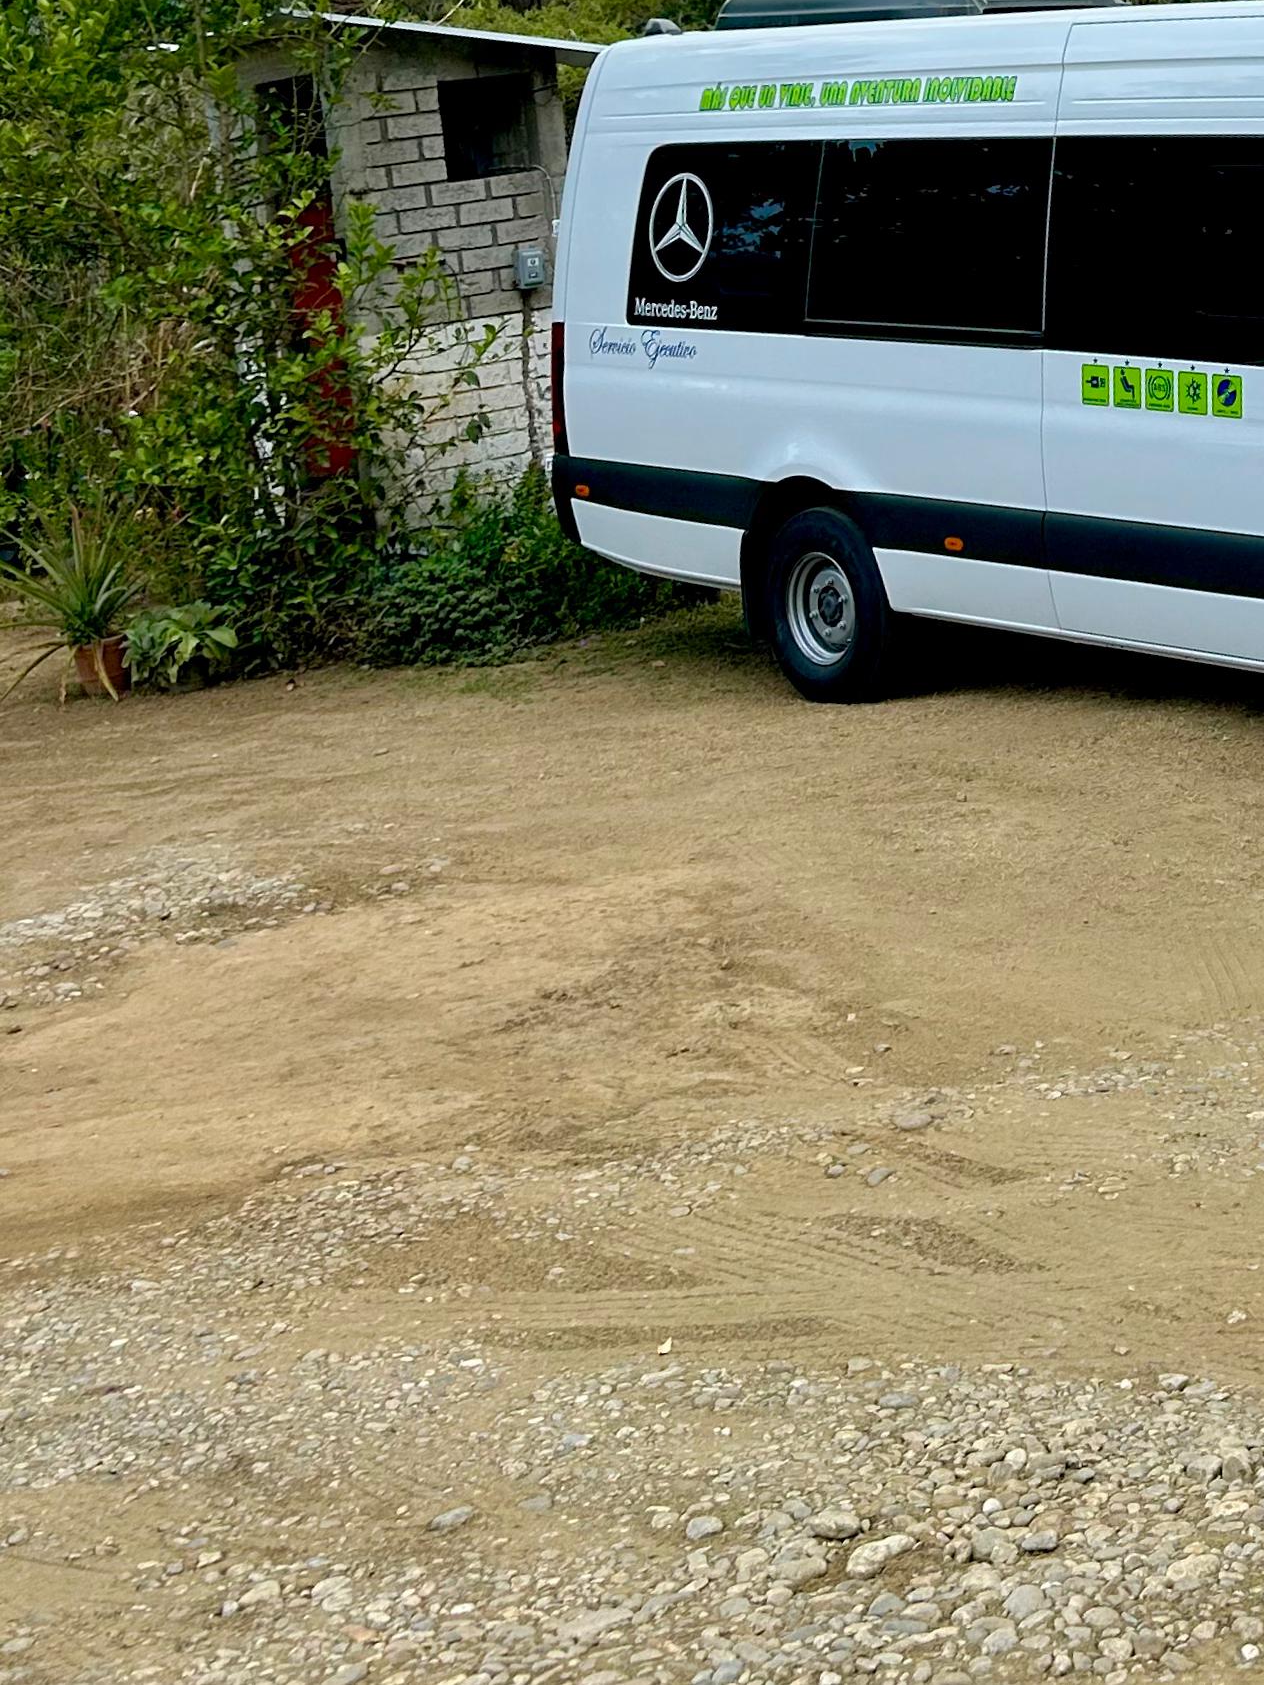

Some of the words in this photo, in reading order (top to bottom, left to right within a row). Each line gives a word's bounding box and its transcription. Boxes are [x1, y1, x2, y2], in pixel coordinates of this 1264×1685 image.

[729, 86, 757, 111] QUE
[758, 84, 776, 108] UN
[819, 81, 848, 107] UNA
[849, 78, 922, 106] AVENTURA
[923, 76, 1017, 104] INOLVIDABLE
[634, 297, 718, 321] Mercedes-Benz
[589, 326, 637, 359] Servicio
[641, 330, 698, 370] Ejecutivo
